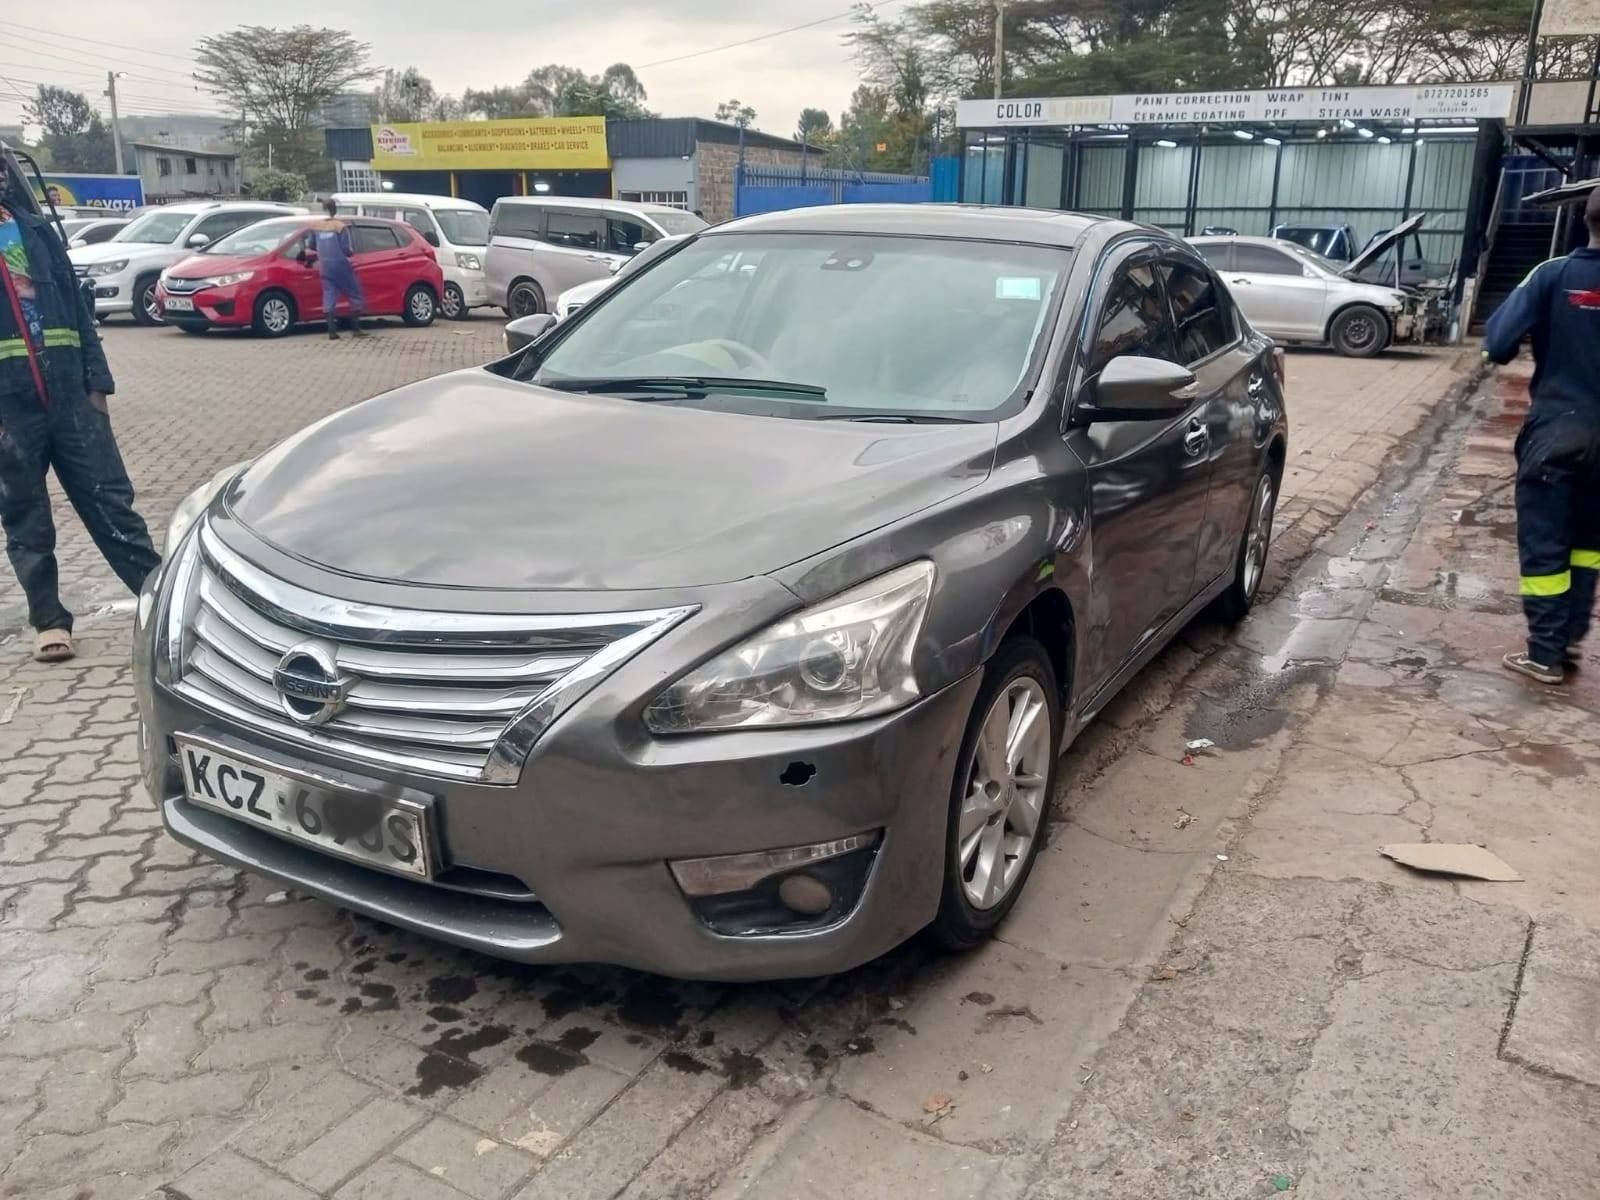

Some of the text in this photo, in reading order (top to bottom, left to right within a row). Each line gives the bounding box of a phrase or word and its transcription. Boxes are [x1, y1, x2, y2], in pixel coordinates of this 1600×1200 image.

[1135, 92, 1350, 106] PAINT CORRECTION WRAP TINT
[997, 103, 1042, 119] COLOR
[1134, 107, 1411, 121] CERAMIC COATING PPF STEAM WASH
[529, 127, 557, 136] BATTERIES
[561, 126, 582, 135] WHEELS
[530, 142, 550, 151] BRAKES
[554, 141, 565, 150] CAR
[566, 141, 590, 150] SERVICE
[187, 750, 273, 821] KCZ
